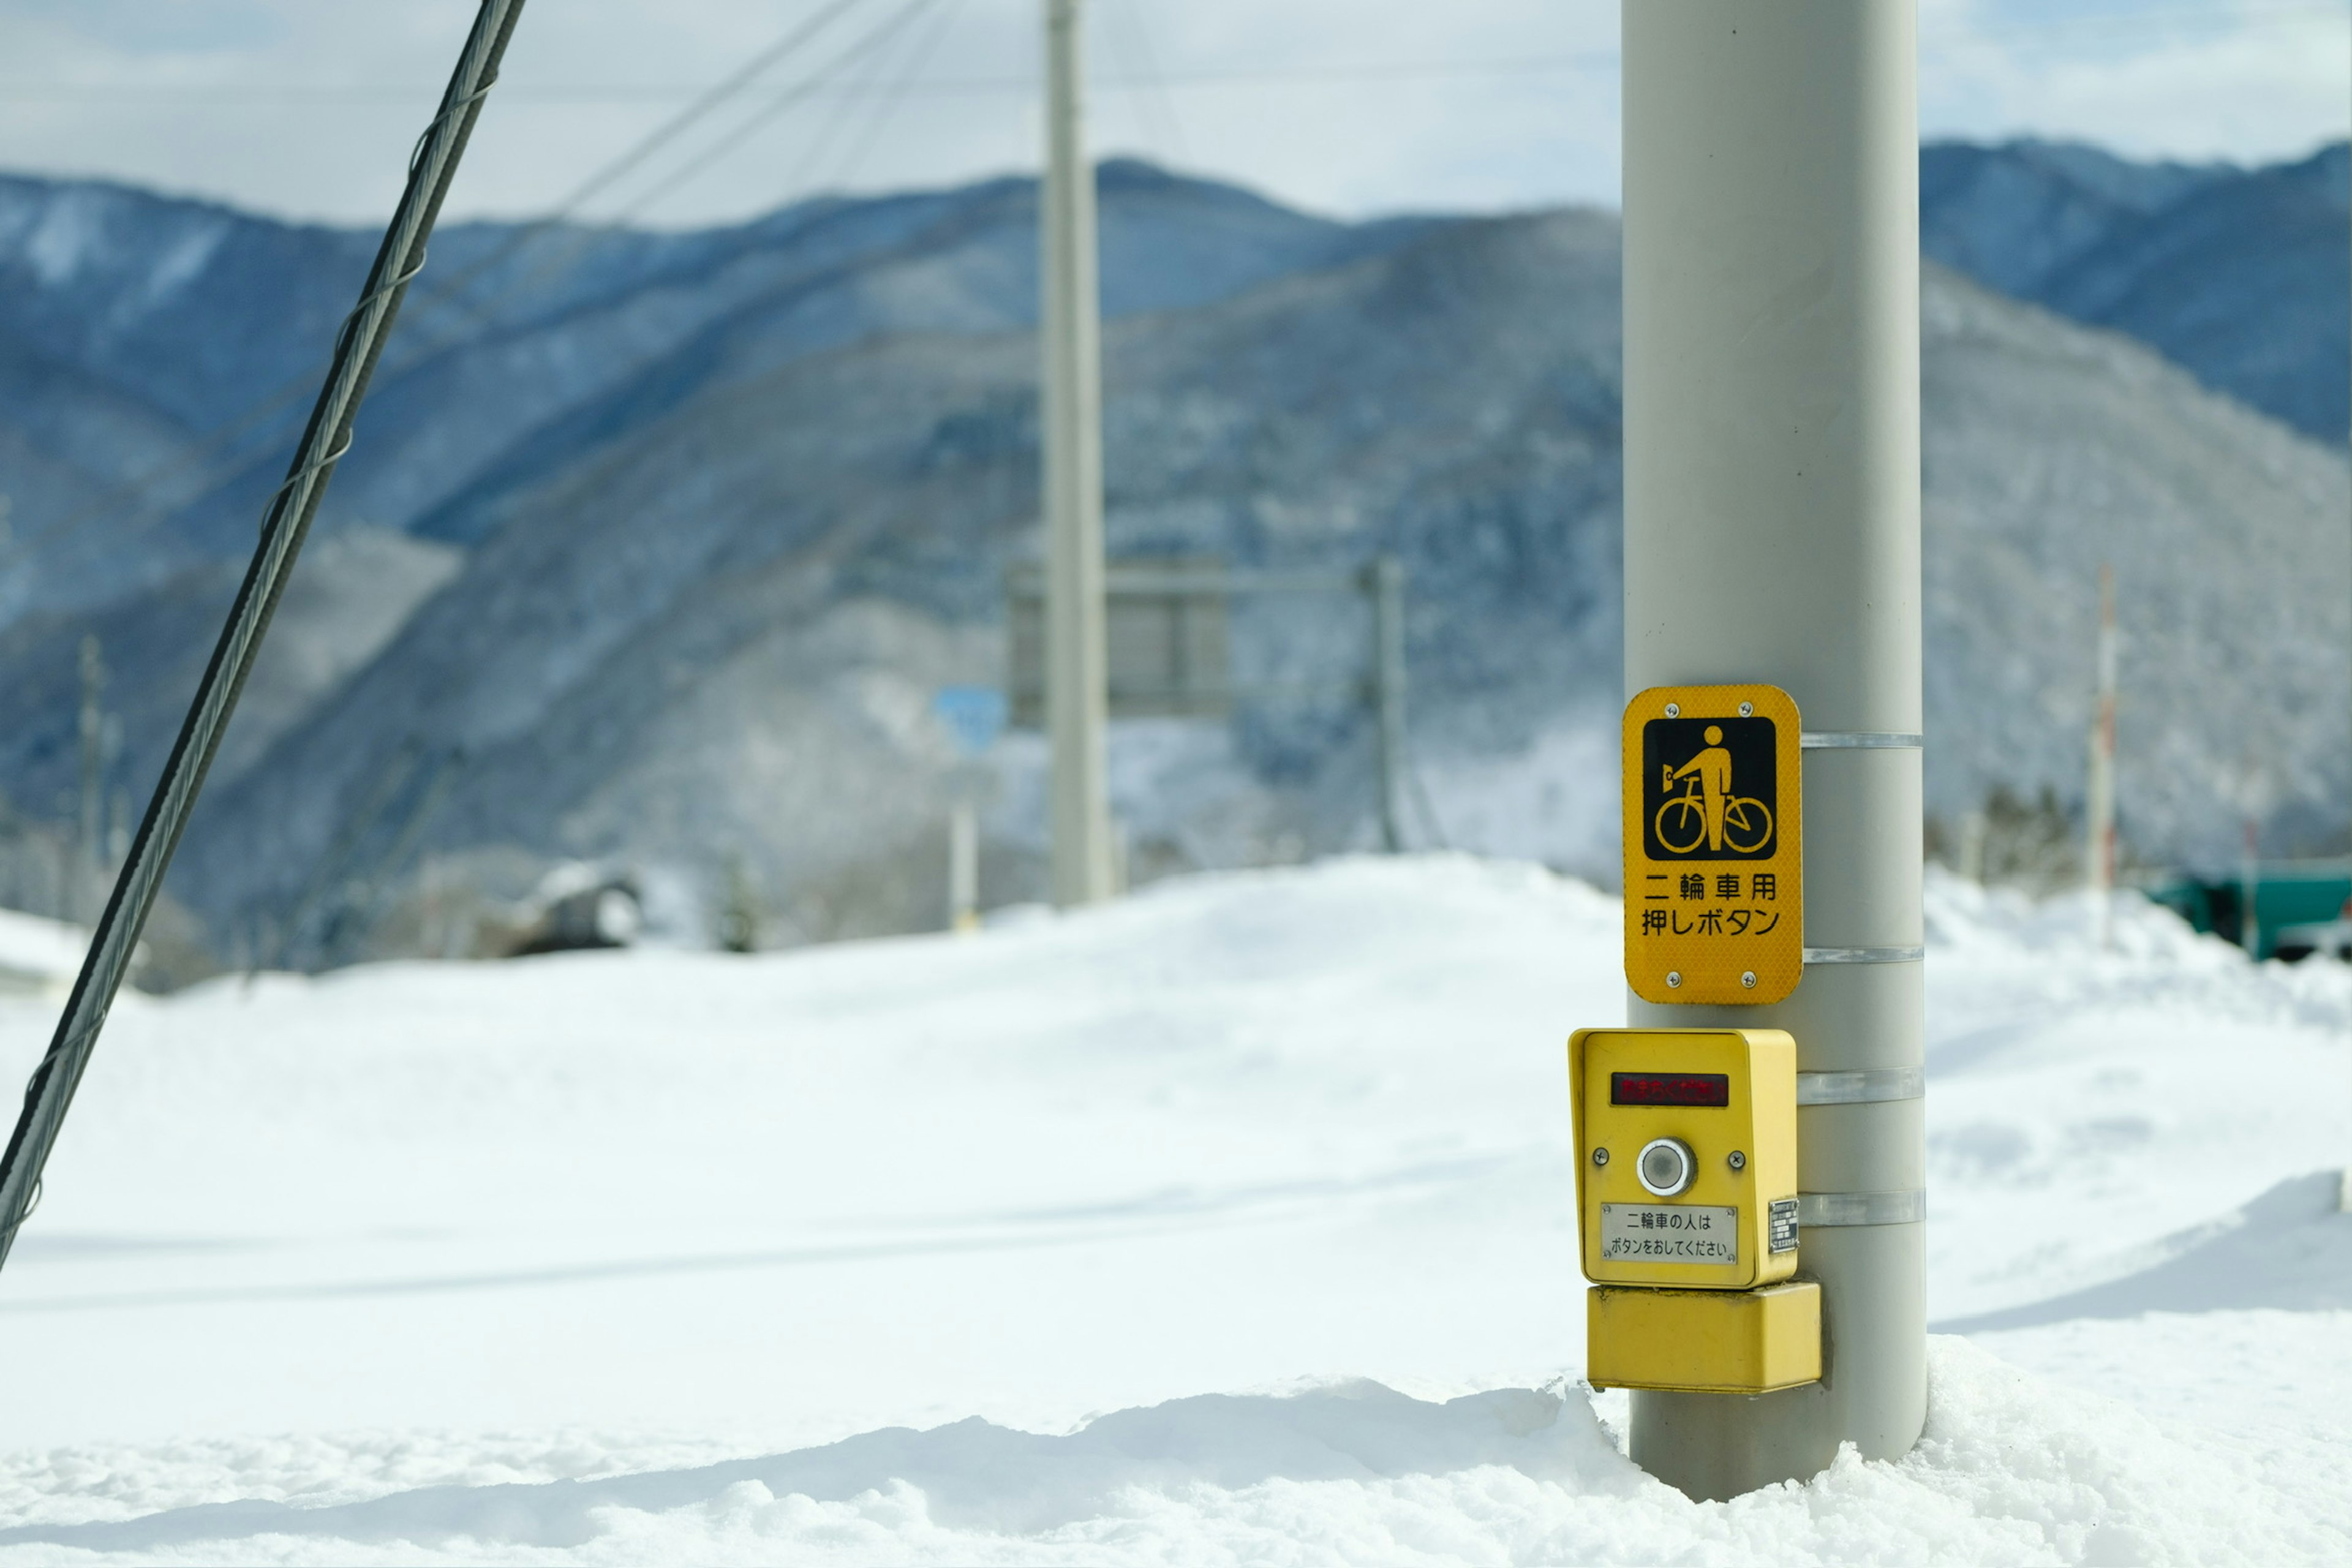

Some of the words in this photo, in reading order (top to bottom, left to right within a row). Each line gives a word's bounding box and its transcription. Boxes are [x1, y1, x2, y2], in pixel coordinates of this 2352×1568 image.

[1645, 873, 1776, 900] 二輪車用
[1642, 909, 1779, 936] 押しボタン
[1627, 1212, 1711, 1231] 二輪車の人は
[1611, 1238, 1727, 1256] ボタンをおしてください
